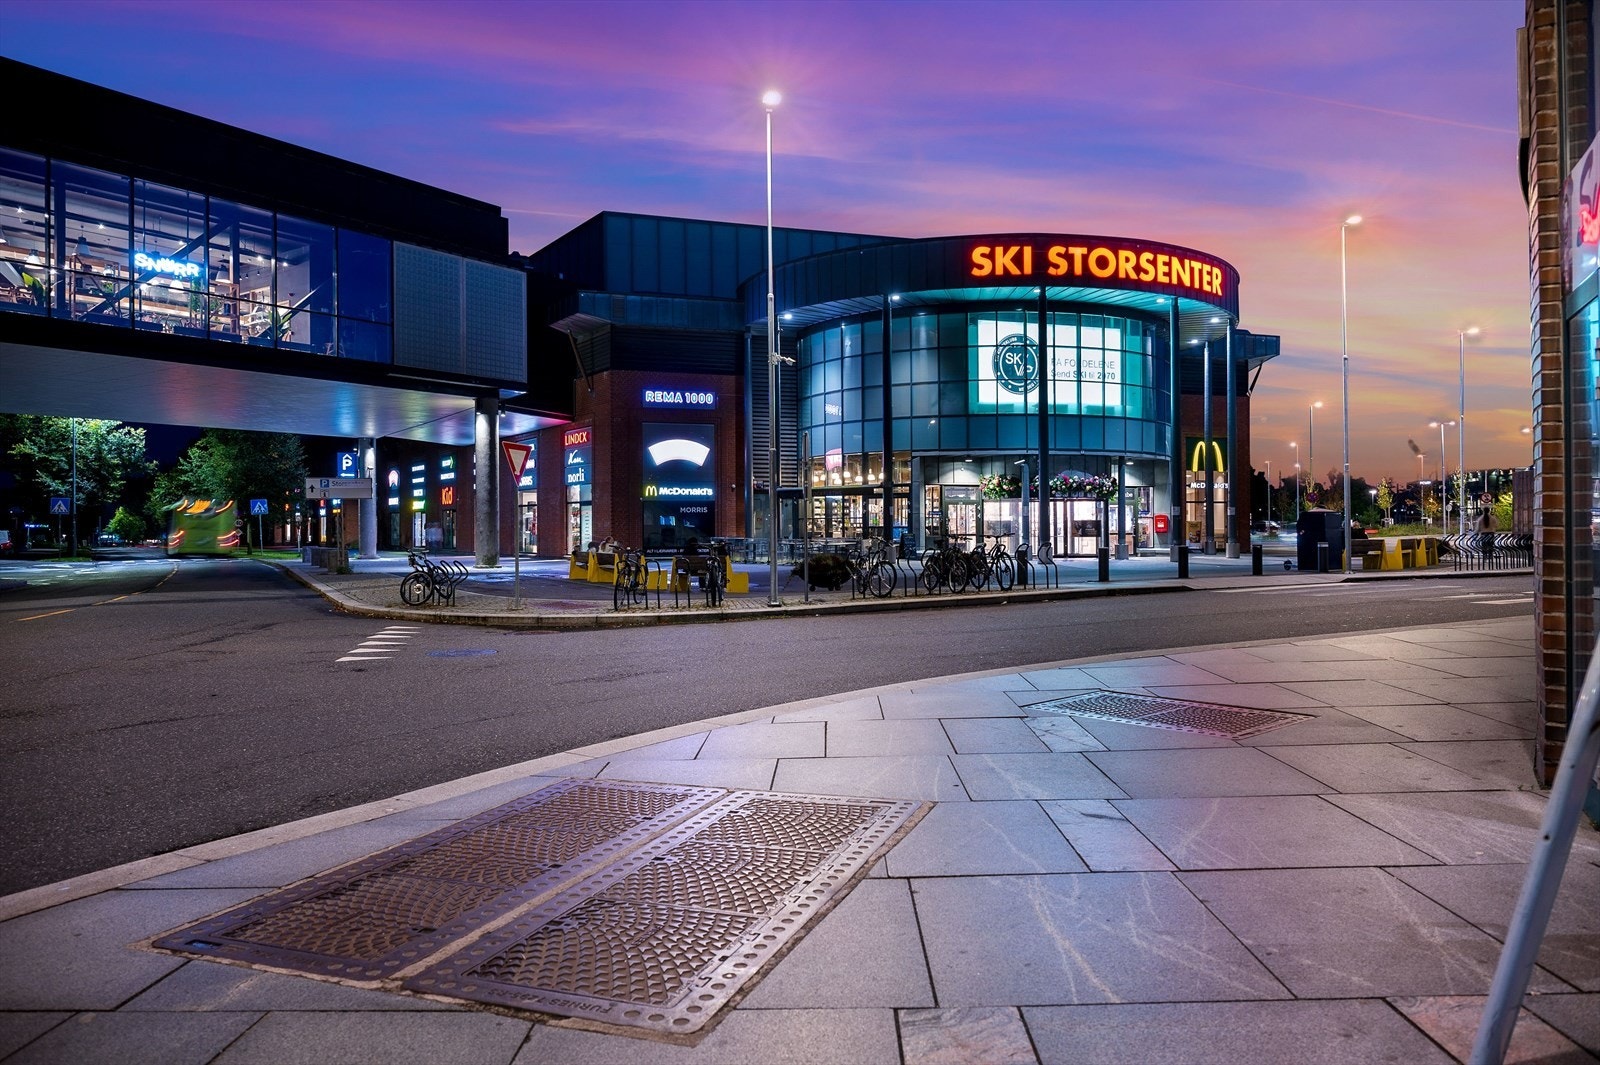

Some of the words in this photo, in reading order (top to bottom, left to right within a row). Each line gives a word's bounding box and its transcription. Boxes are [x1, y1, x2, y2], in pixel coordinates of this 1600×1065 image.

[971, 246, 1032, 277] SKI
[1048, 245, 1223, 297] STORSENTER
[1064, 358, 1116, 369] FODELENE
[645, 390, 683, 403] REMA
[685, 392, 714, 405] 1000
[567, 467, 585, 483] norli
[441, 486, 453, 505] Kid
[658, 486, 713, 496] McDonald's
[548, 998, 612, 1014] FURNES
